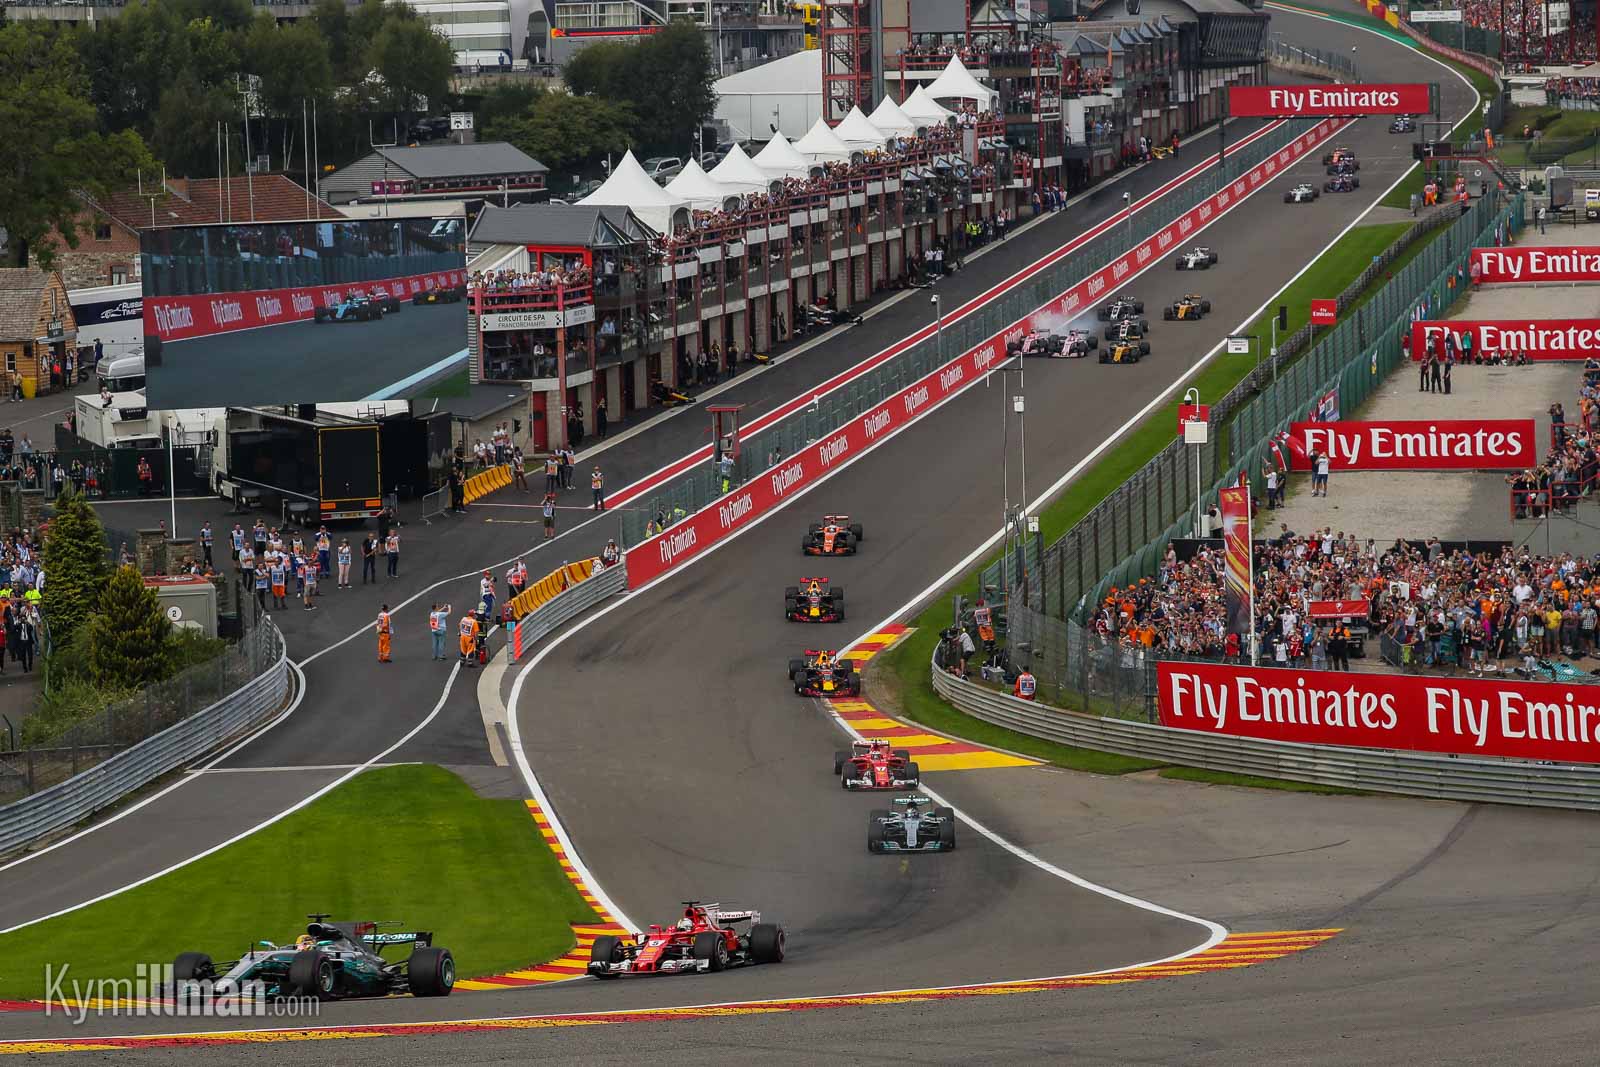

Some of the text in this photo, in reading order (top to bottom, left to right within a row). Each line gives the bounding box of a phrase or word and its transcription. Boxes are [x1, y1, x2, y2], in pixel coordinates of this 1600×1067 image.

[1270, 88, 1399, 111] Fly Emirates
[1480, 252, 1523, 279] Fly
[153, 302, 194, 336] Fly Emirates
[820, 434, 848, 467] Fly Emirates
[1304, 425, 1522, 465] Fly Emirates
[772, 462, 804, 496] Fly Emirates
[719, 493, 753, 529] Fly Emirates
[659, 526, 697, 564] Fly Emirates
[172, 610, 177, 618] 2
[1170, 672, 1399, 730] Fly Emirates
[1426, 687, 1489, 746] Fly
